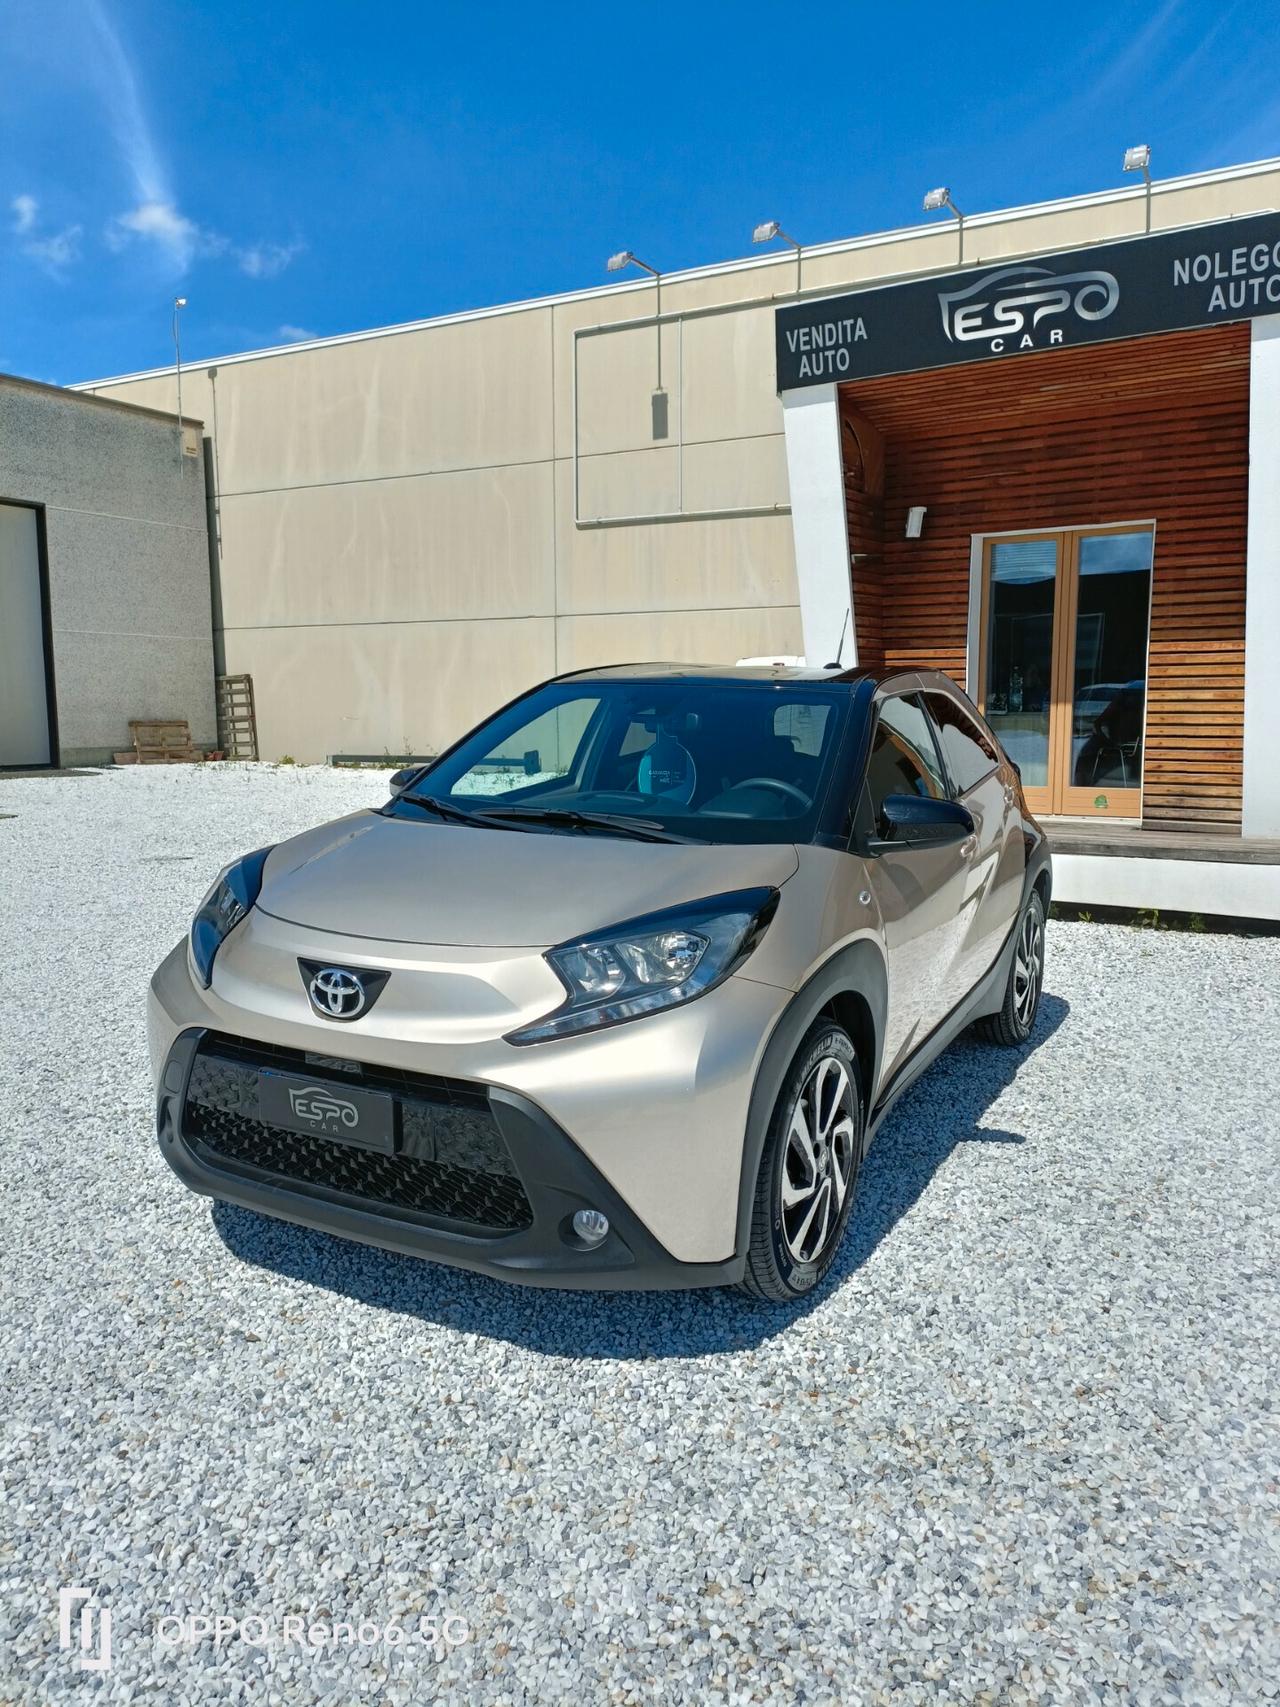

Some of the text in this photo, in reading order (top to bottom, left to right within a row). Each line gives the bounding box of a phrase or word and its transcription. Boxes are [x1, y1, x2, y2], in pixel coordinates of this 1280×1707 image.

[952, 271, 1120, 341] ESPO
[786, 317, 868, 353] VENDITA
[990, 329, 1064, 352] CAR
[799, 347, 850, 378] AUTO
[295, 1097, 359, 1128] ESPO
[309, 1120, 339, 1133] CAR
